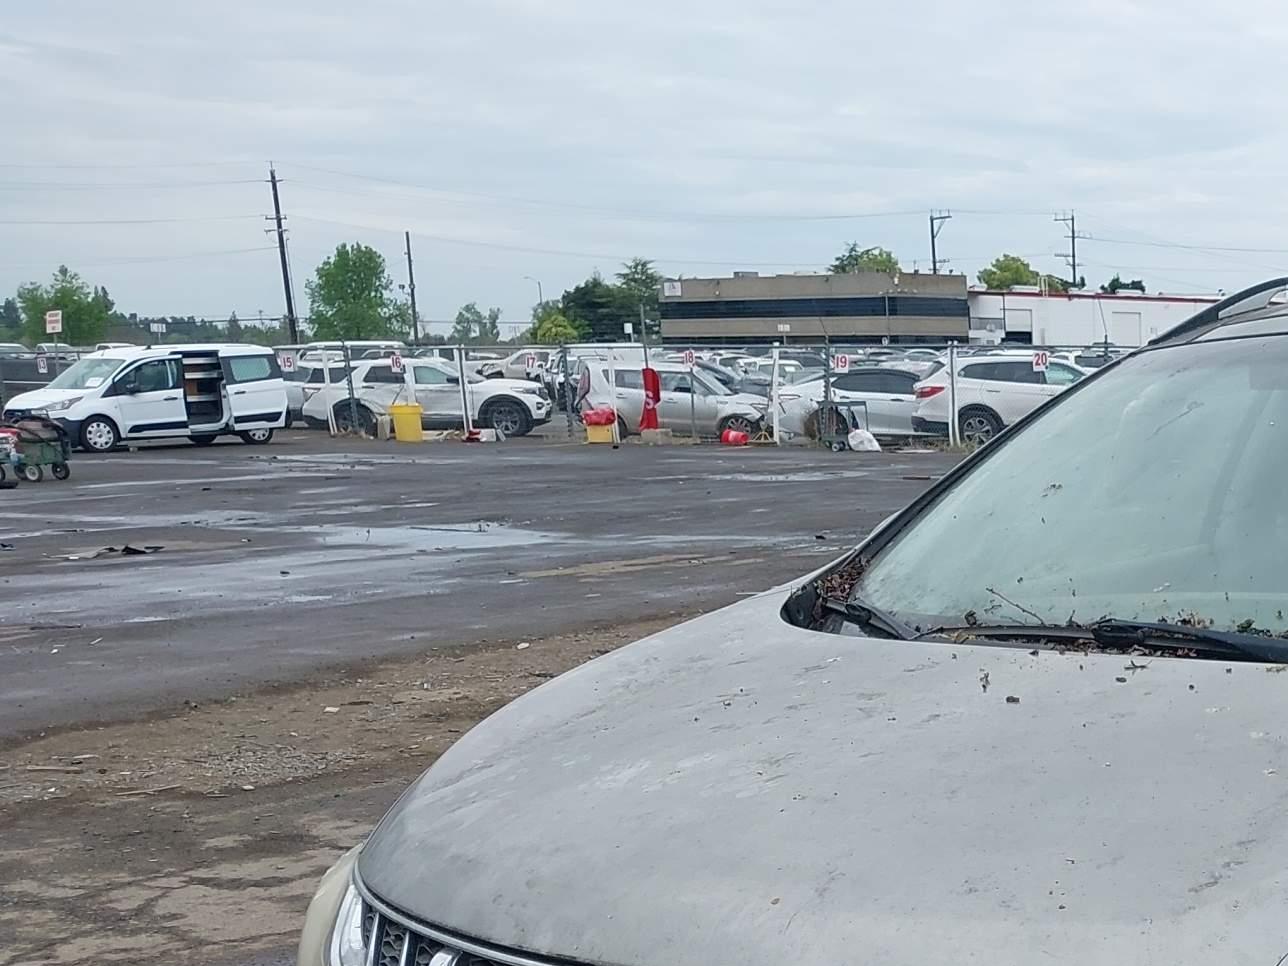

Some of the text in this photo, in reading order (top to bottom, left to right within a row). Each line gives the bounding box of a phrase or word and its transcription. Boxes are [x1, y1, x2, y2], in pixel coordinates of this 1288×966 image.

[282, 356, 294, 368] 15
[391, 355, 402, 368] 16
[526, 356, 537, 368] 17
[684, 351, 694, 363] 18
[835, 355, 848, 368] 19
[1034, 352, 1047, 367] 20
